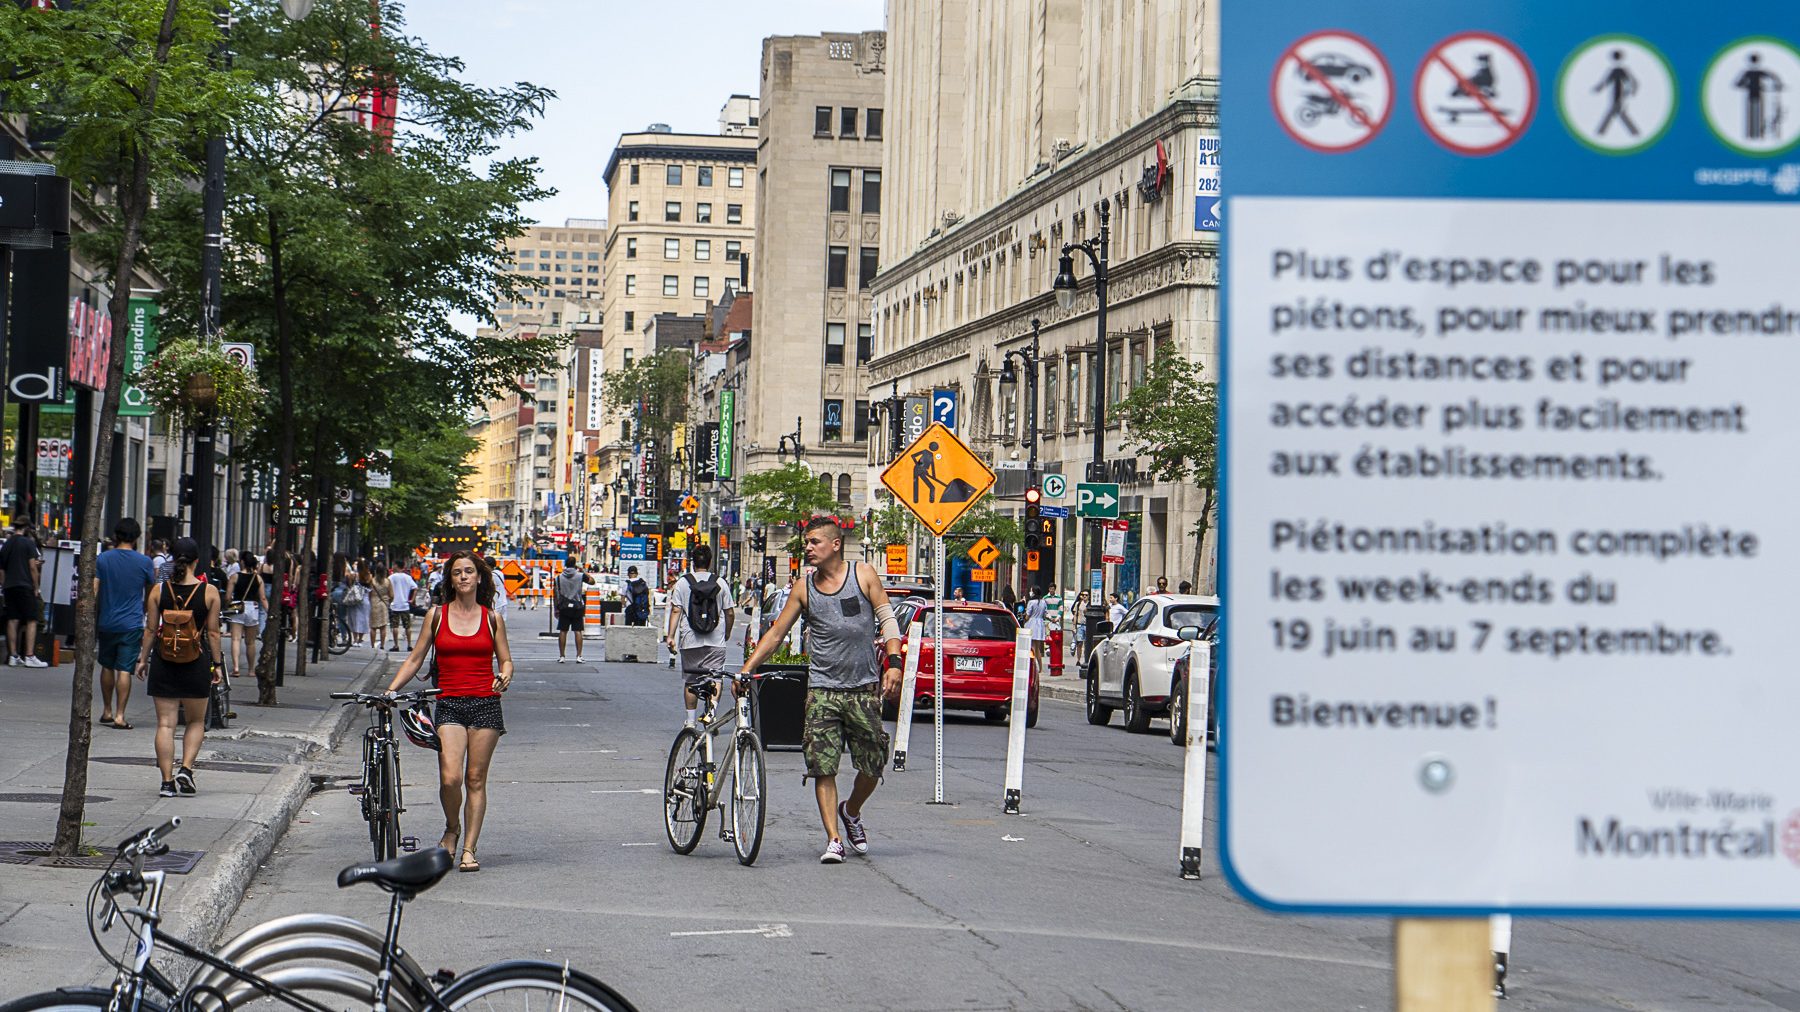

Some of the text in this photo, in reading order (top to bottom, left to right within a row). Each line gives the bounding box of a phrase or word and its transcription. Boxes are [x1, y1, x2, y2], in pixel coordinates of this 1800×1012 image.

[1272, 250, 1715, 288] Plus d'espace pour les
[1271, 298, 1800, 339] piétons, pour mieux prendr
[70, 297, 112, 392] GARAG
[131, 307, 145, 380] esjardins
[1271, 348, 1691, 387] ses distances et pour
[1270, 396, 1745, 434] accéder plus facilement
[706, 429, 719, 473] Moores
[721, 404, 729, 476] PHARMACIE
[1270, 444, 1662, 480] aux établissements.
[1271, 520, 1758, 560] Piétonnisation complète
[1271, 570, 1616, 605] les week-ends du
[1271, 619, 1731, 659] 19 juin au 7 septembre.
[1577, 816, 1775, 858] Montréal
